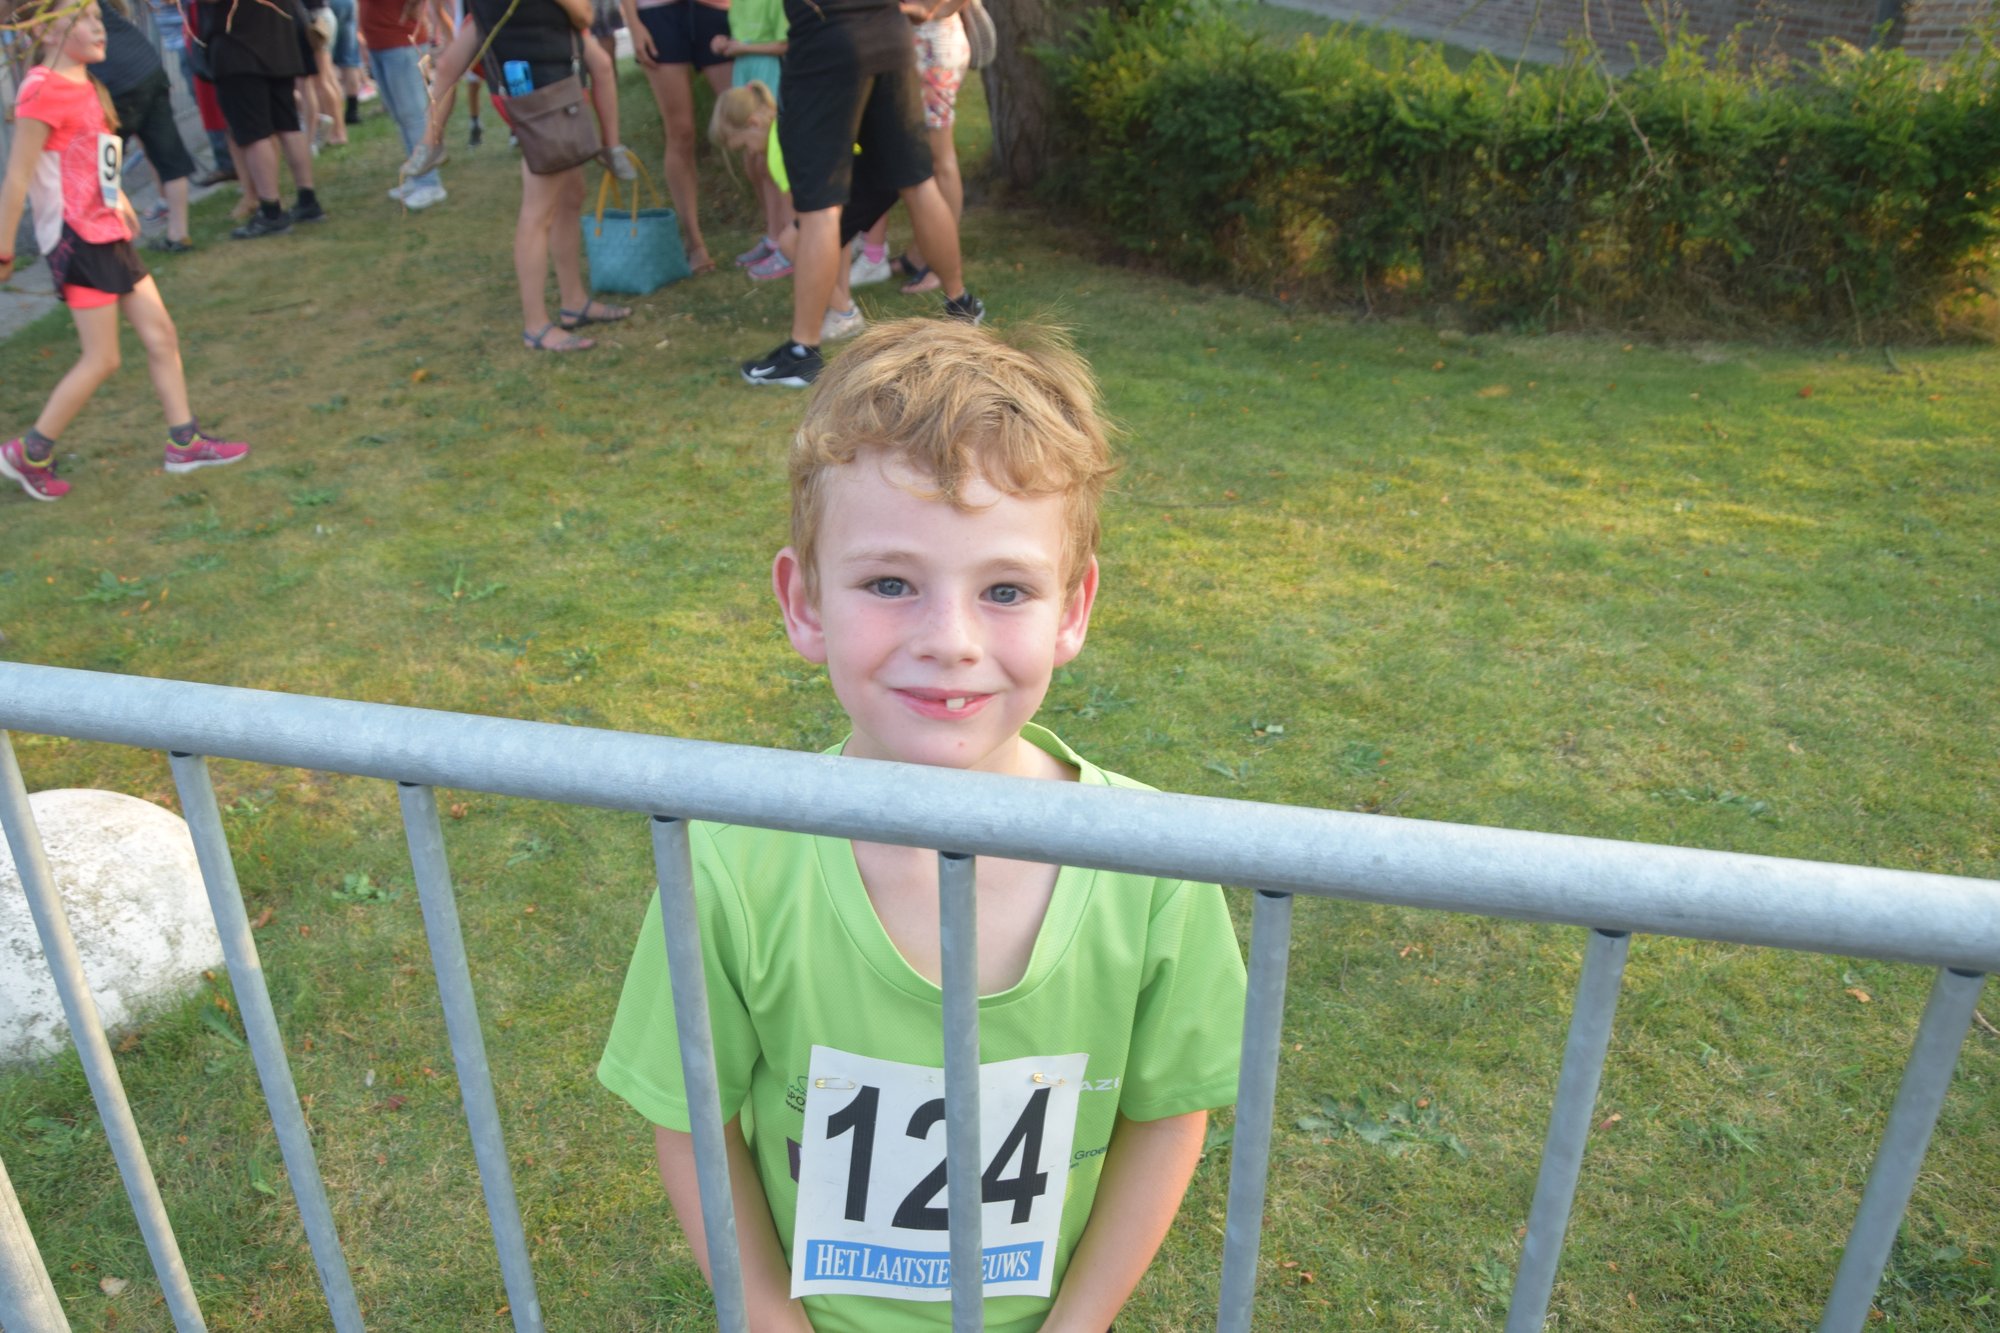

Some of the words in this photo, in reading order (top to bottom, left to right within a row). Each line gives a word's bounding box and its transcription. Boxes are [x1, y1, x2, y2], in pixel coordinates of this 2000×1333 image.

[826, 1085, 1052, 1231] 124
[815, 1244, 860, 1277] HET
[860, 1248, 951, 1285] LAATSTE
[981, 1250, 1032, 1280] EUWS
